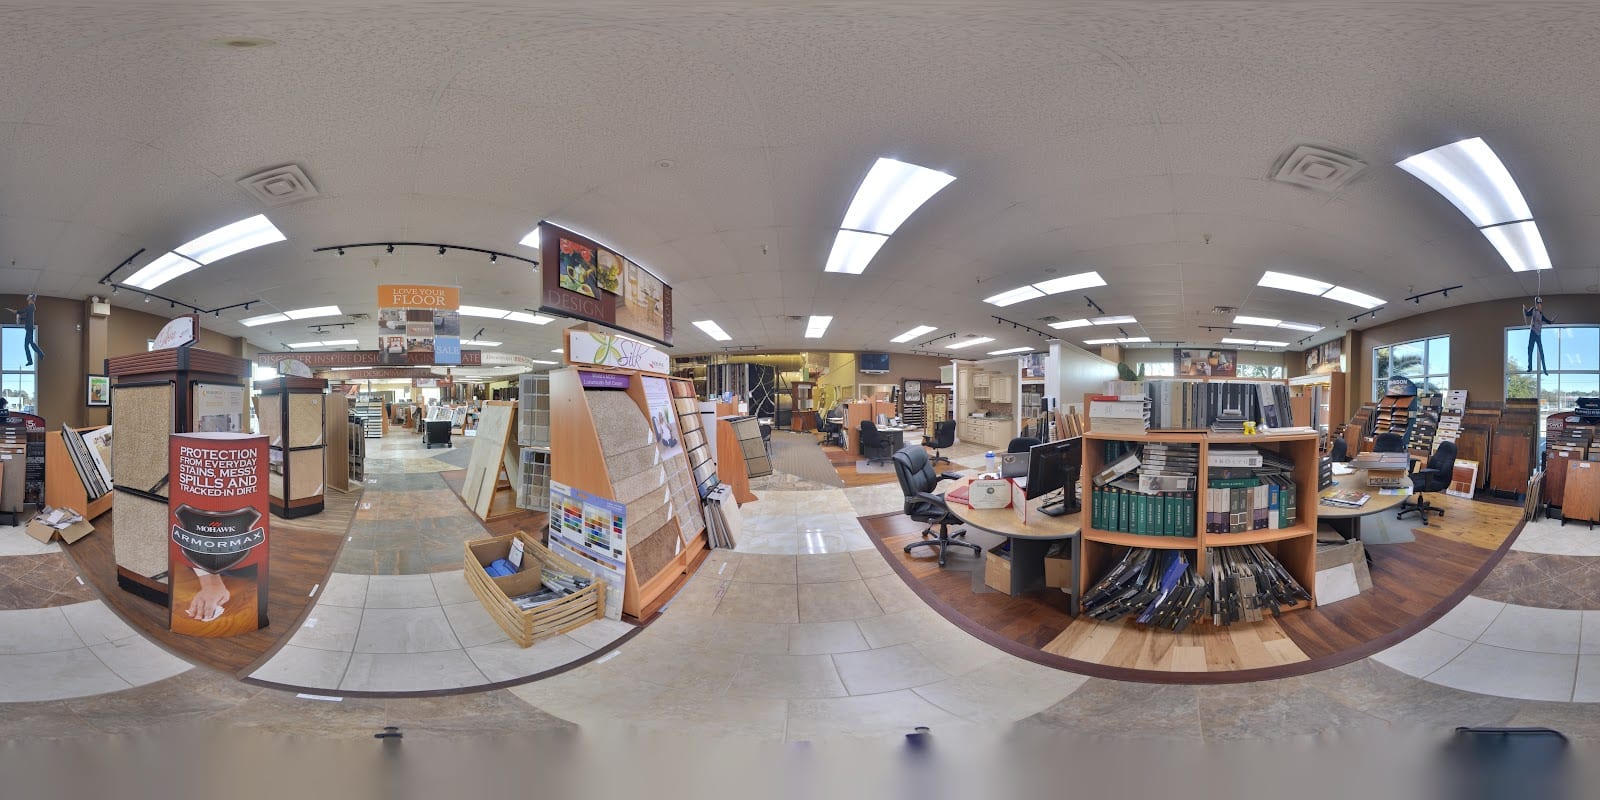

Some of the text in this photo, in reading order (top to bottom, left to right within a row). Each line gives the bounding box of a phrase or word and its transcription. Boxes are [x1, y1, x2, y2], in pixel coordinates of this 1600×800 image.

[420, 288, 445, 296] YOUR
[393, 294, 446, 306] FLOOR
[548, 289, 604, 318] DESIGN
[436, 346, 459, 354] SALE
[617, 340, 649, 368] Silk
[314, 352, 352, 364] INSPIRE
[180, 446, 257, 460] PROTECTION
[180, 456, 257, 468] FROM EVERYDAY
[180, 464, 257, 478] STAINS, MESSY
[179, 473, 257, 489] SPILLS AND
[179, 483, 234, 496] TRACKED-IN
[196, 525, 236, 533] MOHAWK
[174, 530, 261, 548] ARMORMAX
